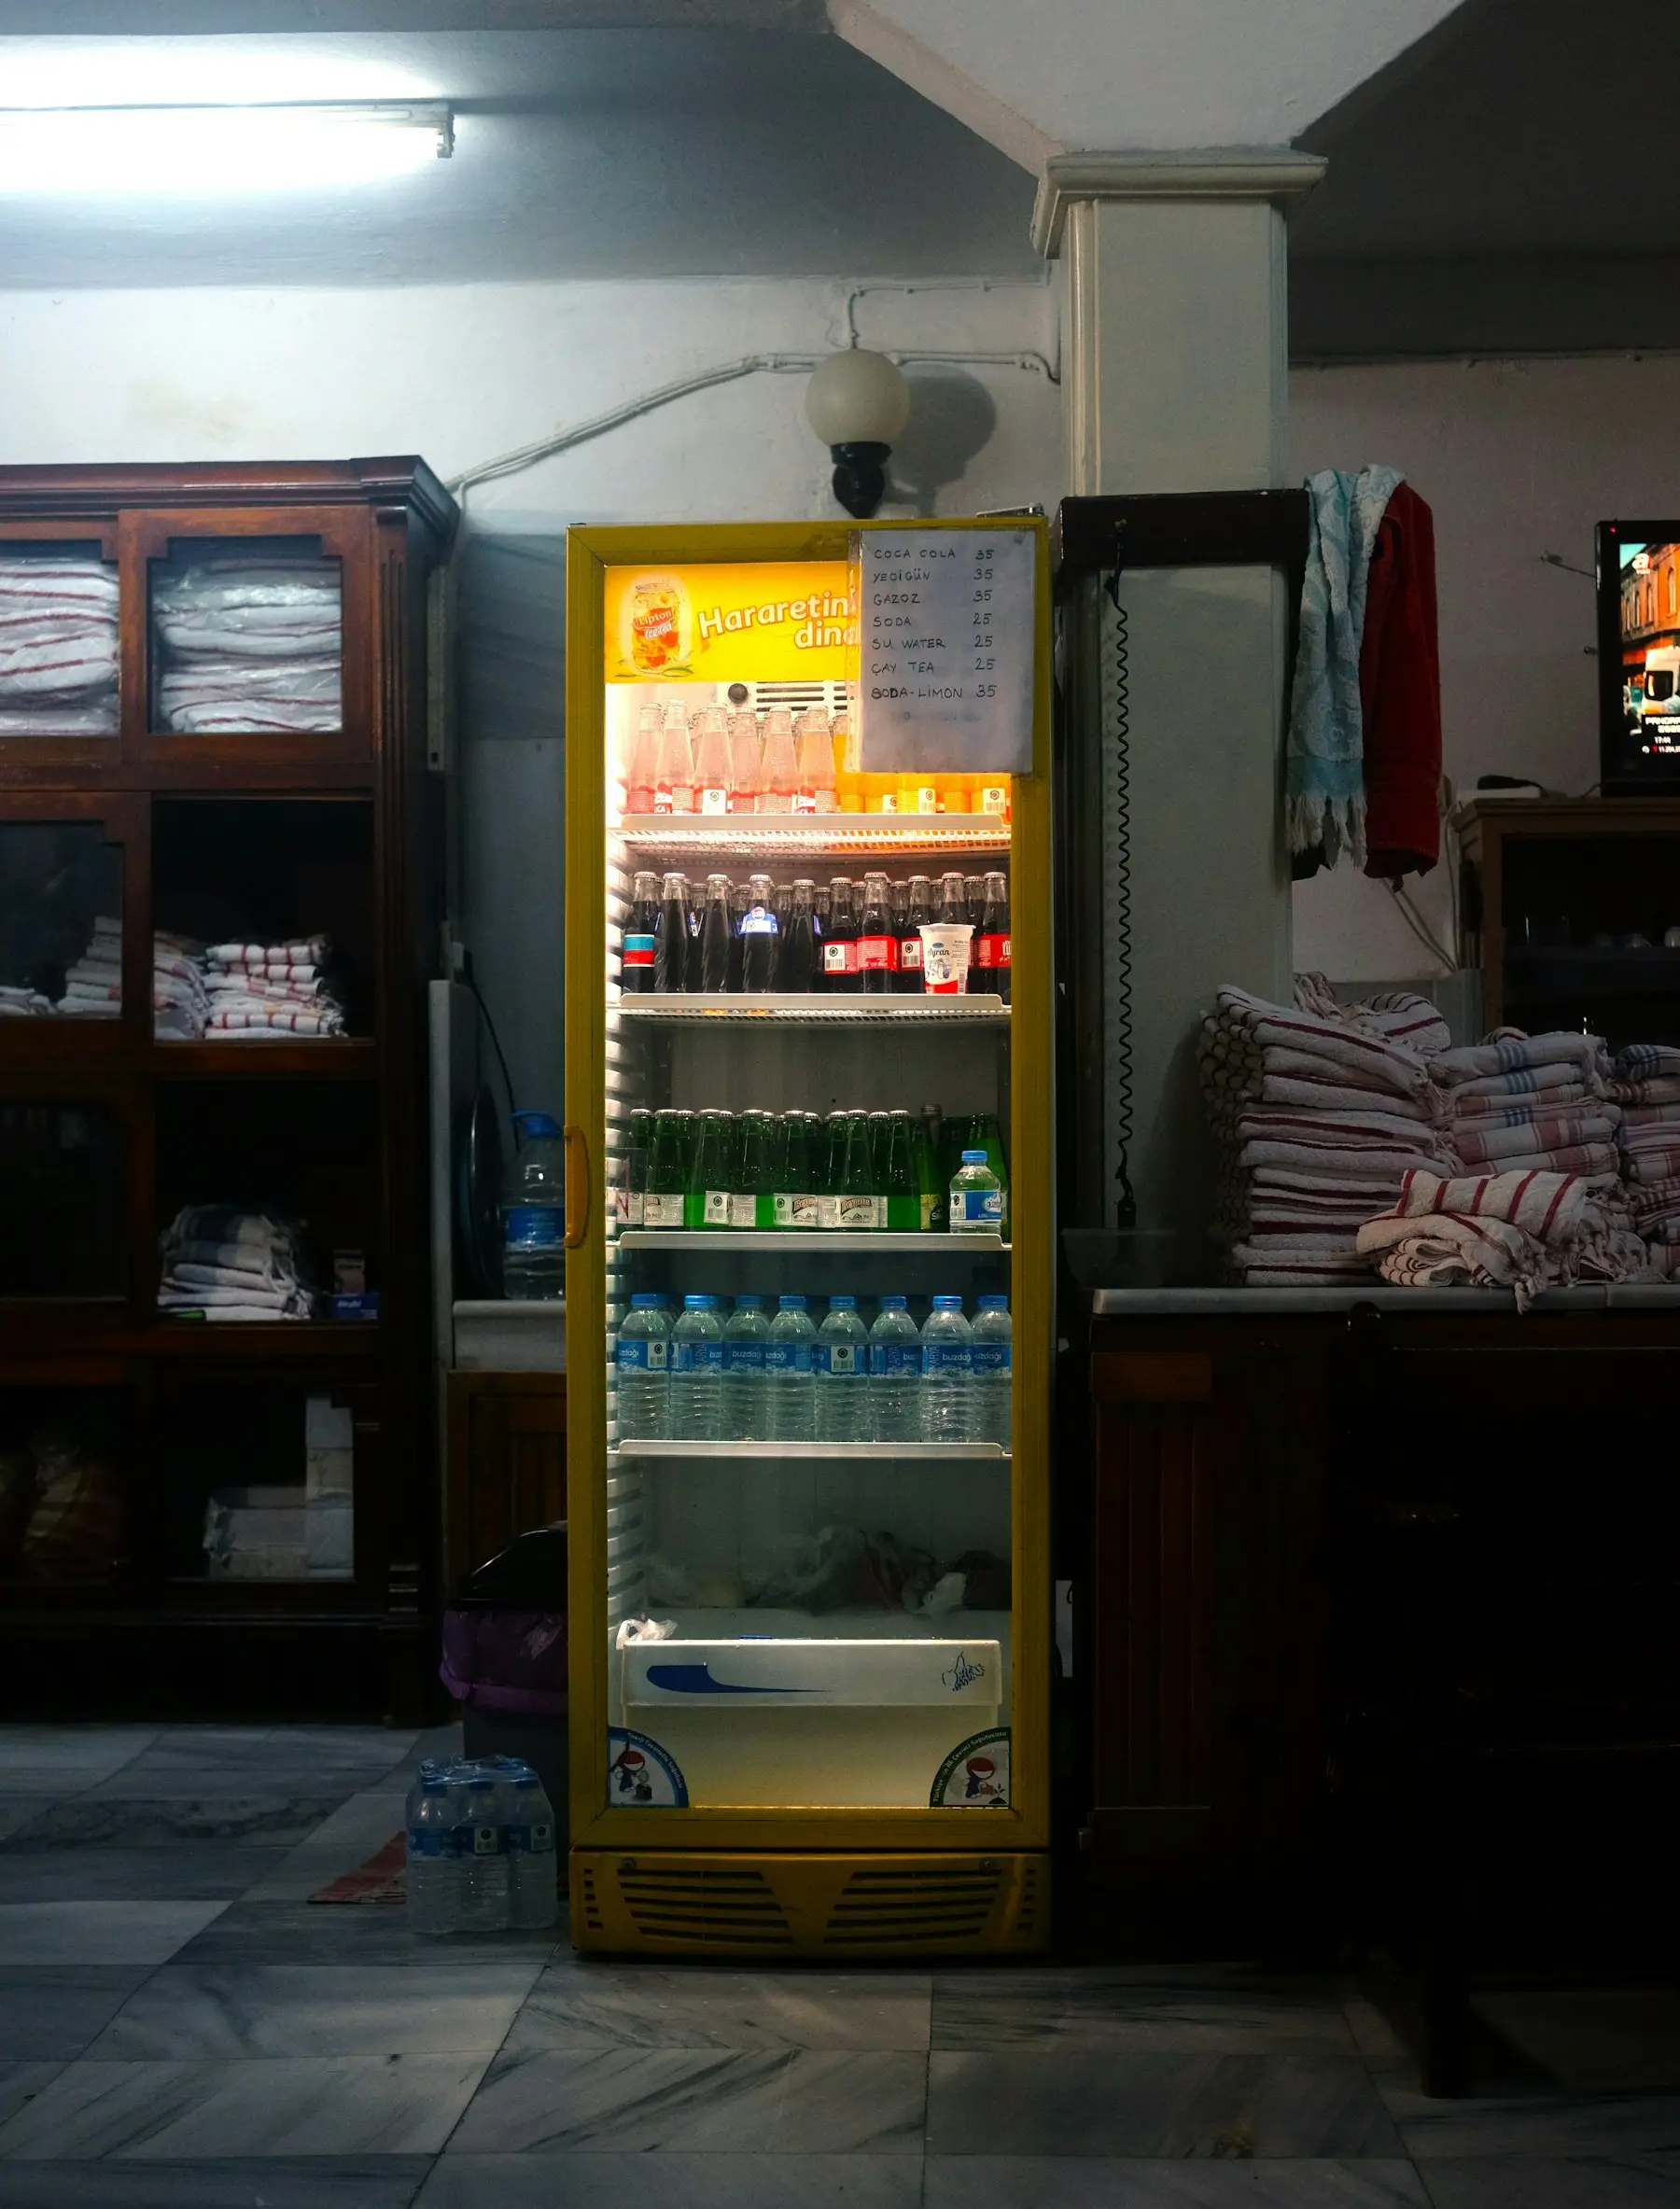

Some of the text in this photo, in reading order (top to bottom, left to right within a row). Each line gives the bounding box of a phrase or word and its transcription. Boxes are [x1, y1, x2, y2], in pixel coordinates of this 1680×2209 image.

[874, 549, 995, 560] COCA COLA 35
[973, 568, 994, 580] 35
[874, 590, 992, 606] GAZOZ 35
[638, 610, 672, 625] Lipton
[873, 612, 992, 627] SODA 25
[872, 635, 993, 650] SU WATER 25
[872, 658, 996, 676] ÇAY TEA 25
[975, 684, 997, 698] 35
